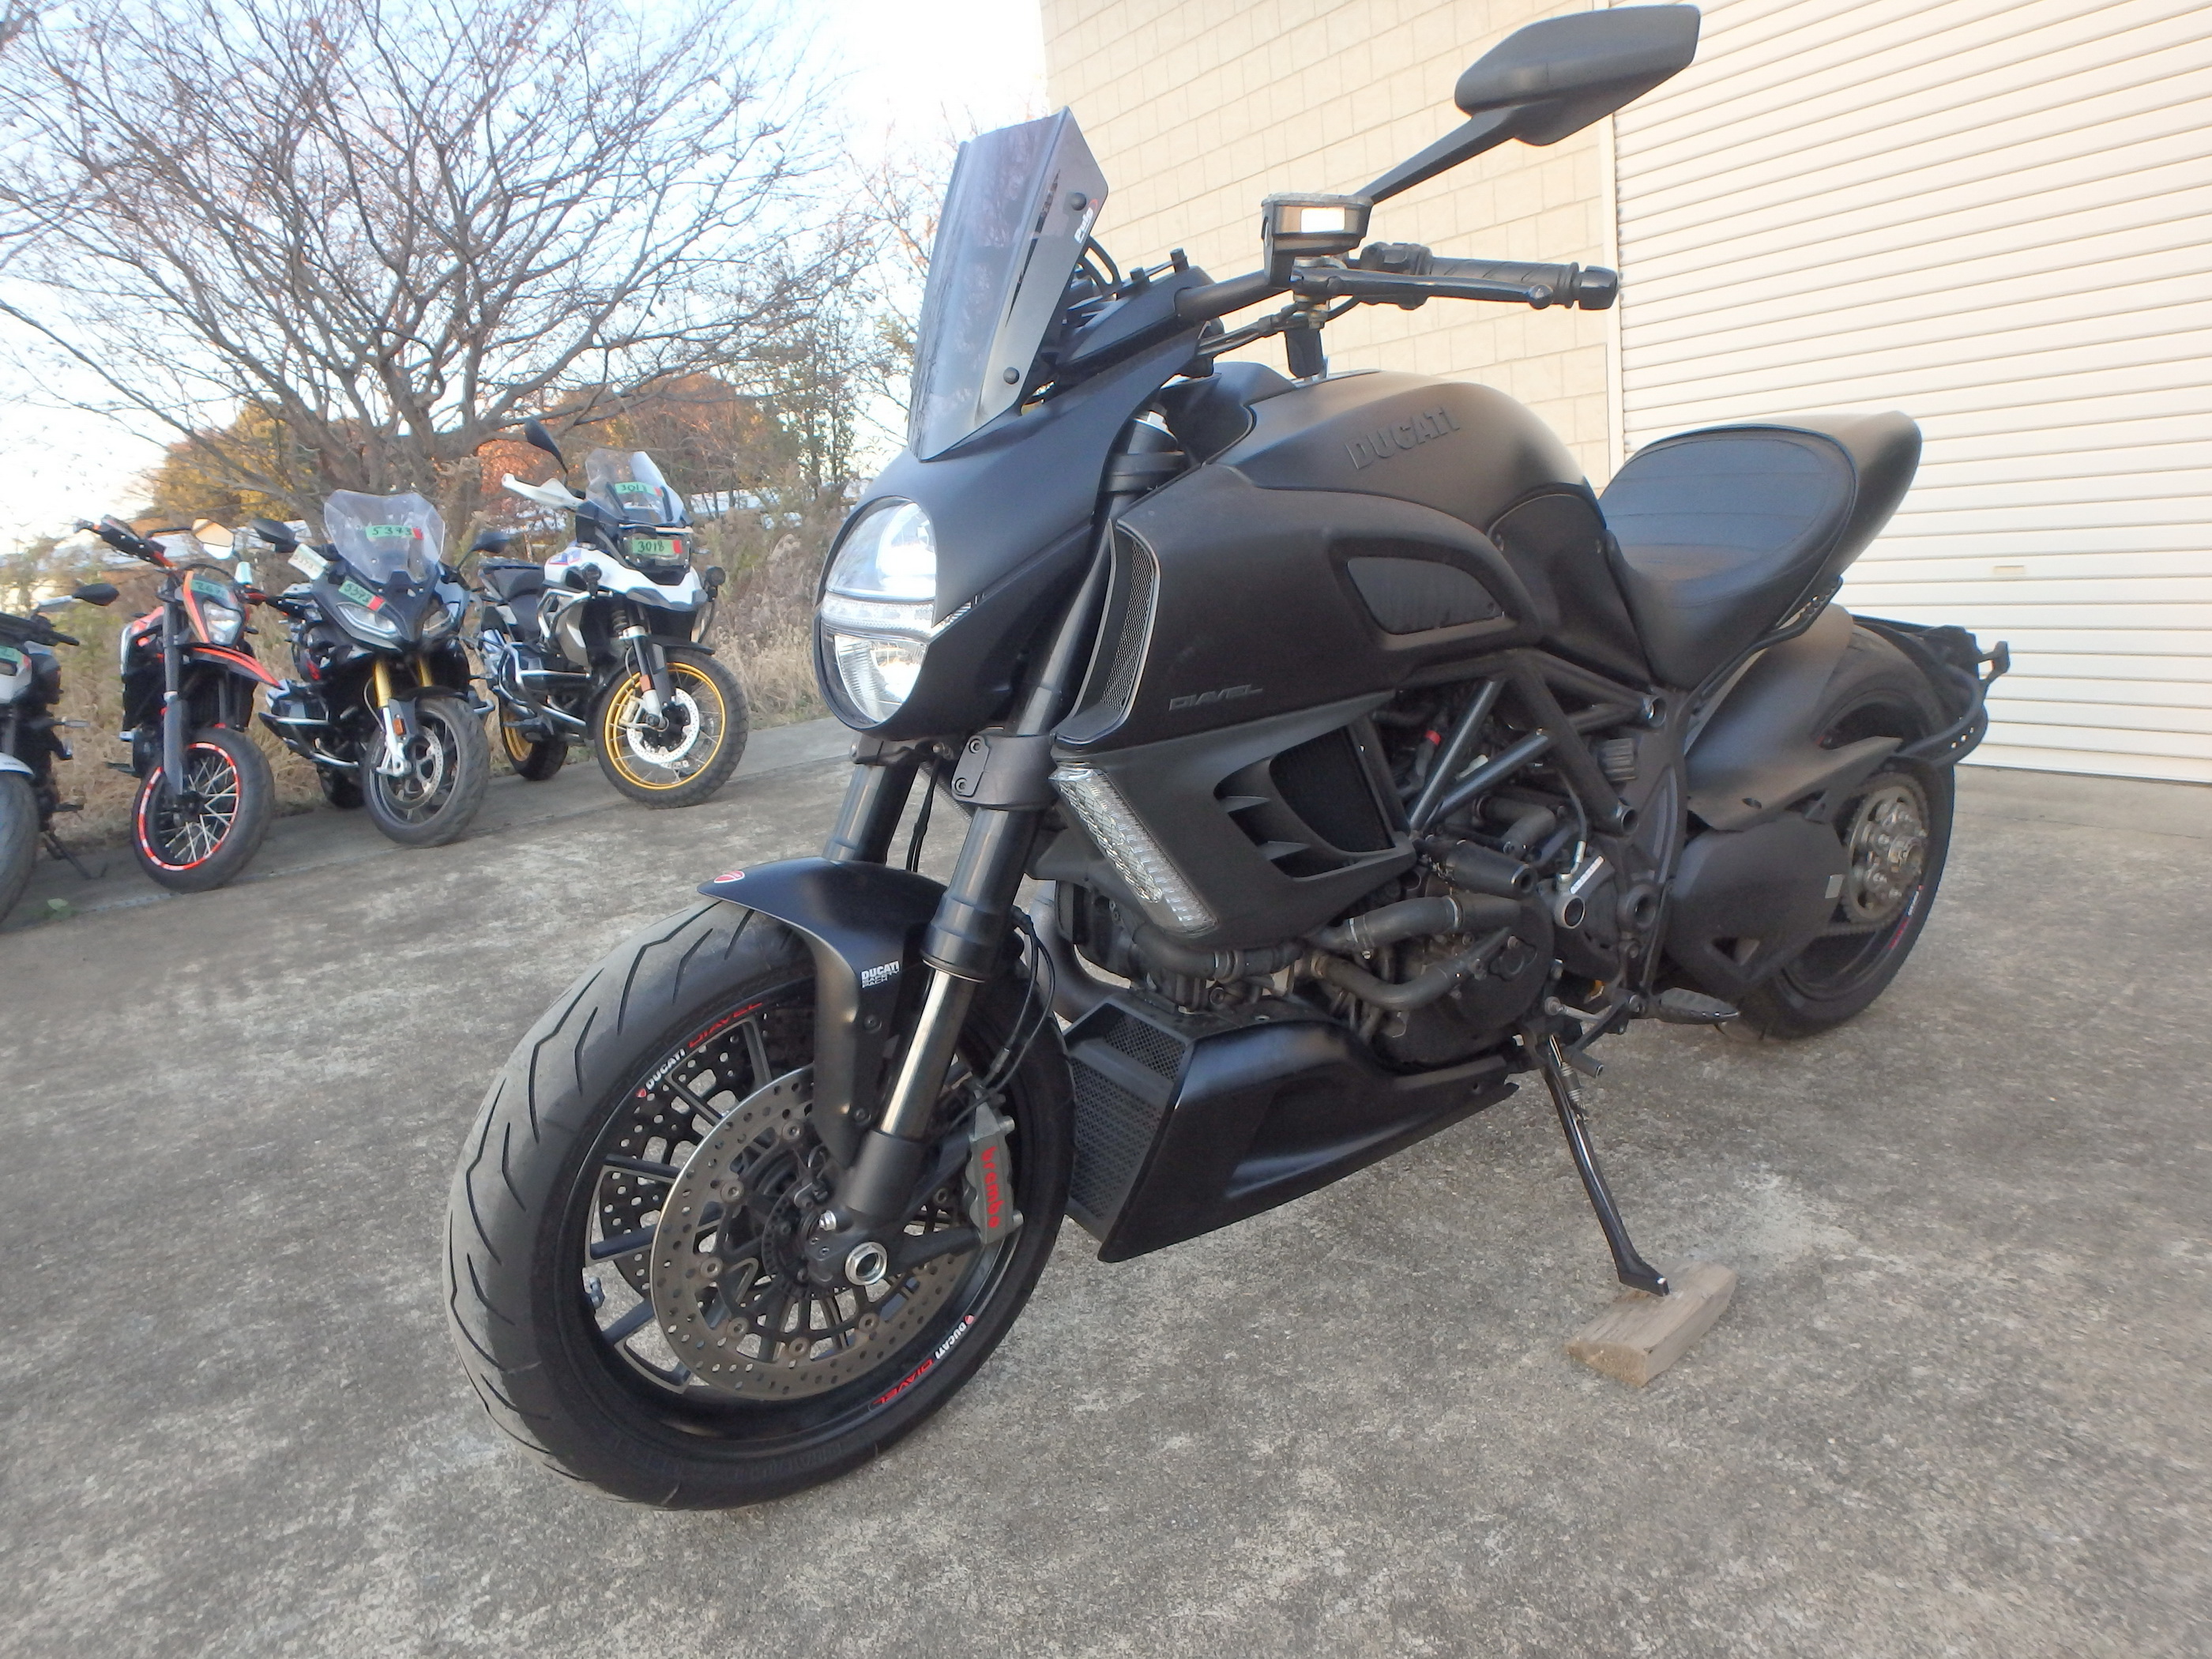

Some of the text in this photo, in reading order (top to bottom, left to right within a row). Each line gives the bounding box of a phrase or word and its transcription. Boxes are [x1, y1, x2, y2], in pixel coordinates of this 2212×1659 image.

[1344, 405, 1461, 470] DUCATI
[638, 540, 665, 553] 3018
[861, 961, 900, 980] DUCATI
[645, 1048, 686, 1089] DUCATI
[981, 1146, 1005, 1228] brembo
[871, 1322, 967, 1405] DUCATI DIAVEL
